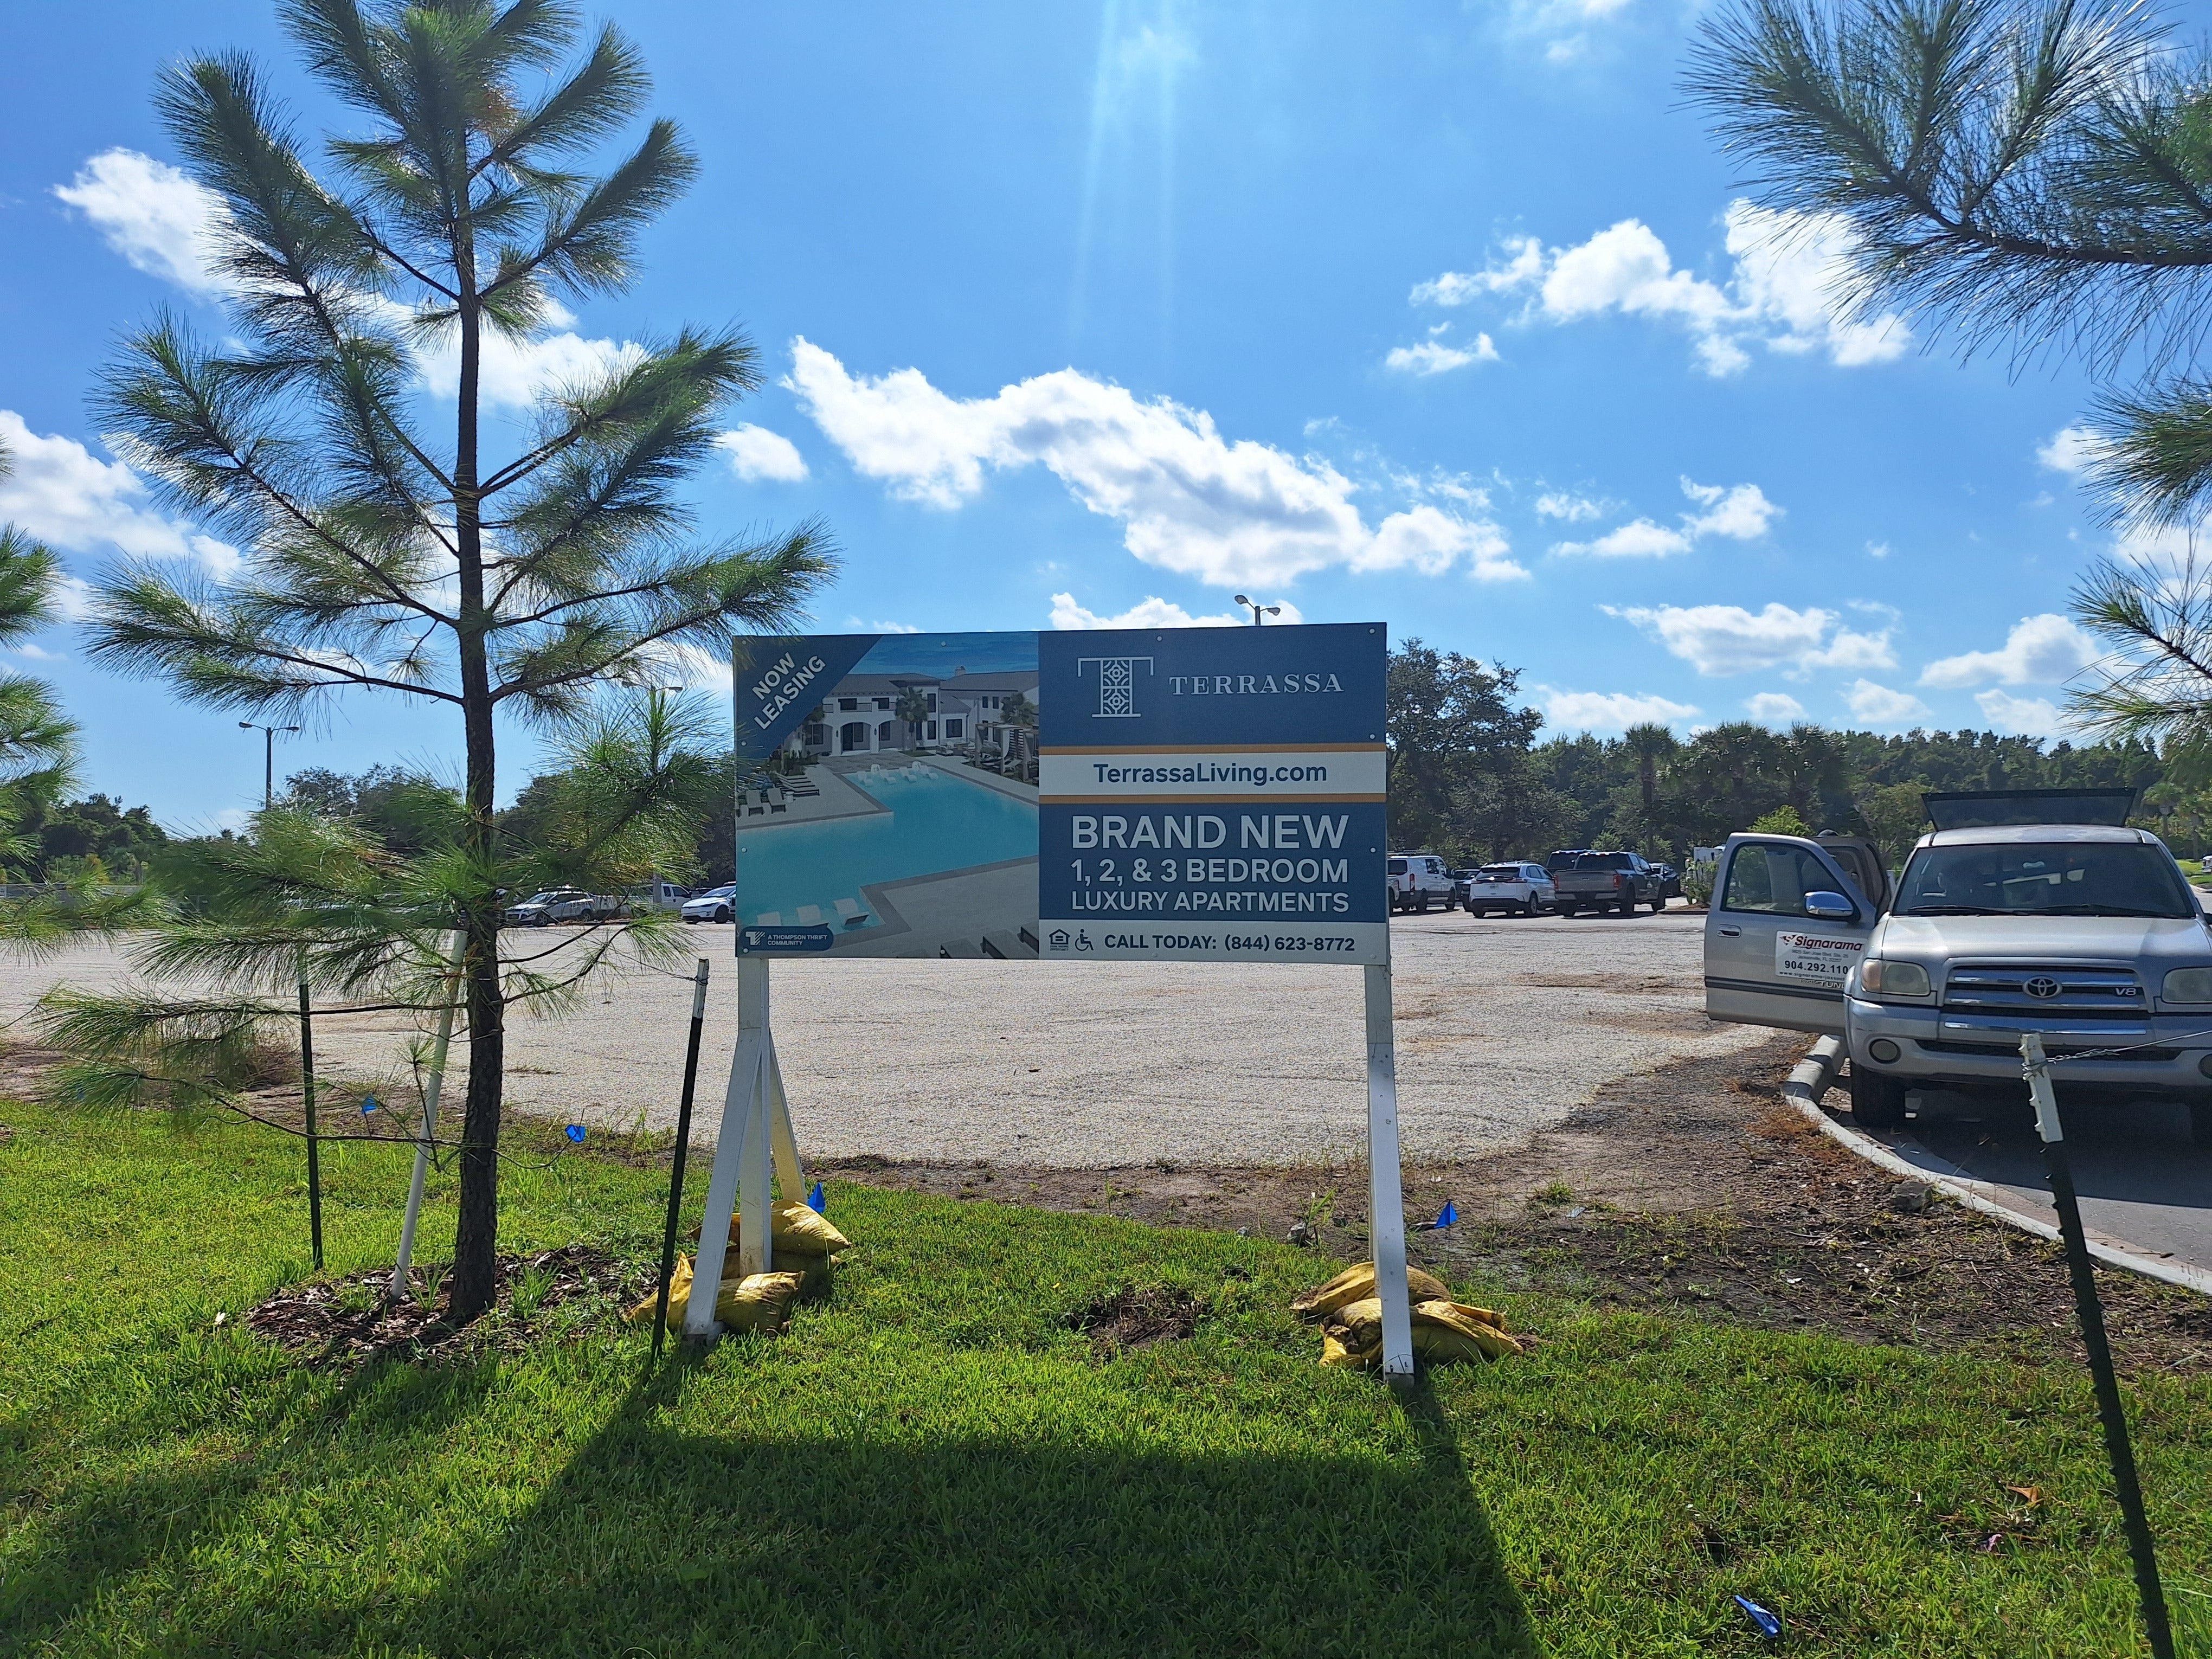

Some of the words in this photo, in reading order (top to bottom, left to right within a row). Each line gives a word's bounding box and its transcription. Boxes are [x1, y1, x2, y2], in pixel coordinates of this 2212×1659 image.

[752, 652, 795, 700] NOW
[1169, 673, 1344, 695] TERRASSA
[754, 656, 826, 730] LEASING
[1093, 763, 1327, 786] TerrassaLiving.com
[1072, 815, 1227, 850] BRAND
[1241, 815, 1349, 849] NEW
[1071, 859, 1091, 886] 1,
[1099, 859, 1123, 886] 2,
[1132, 859, 1152, 883] &
[1160, 859, 1178, 883] 3
[1187, 859, 1348, 883] BEDROOM
[1072, 891, 1168, 911] LUXURY
[1173, 891, 1349, 913] APARTMENTS
[1104, 935, 1149, 949] CALL
[1152, 935, 1217, 949] TODAY:
[1224, 934, 1270, 952] (844)
[1274, 937, 1355, 951] 623-8772
[1795, 936, 1864, 951] Signarama
[1784, 960, 1849, 975] 904.292.110
[2115, 987, 2136, 995] V8
